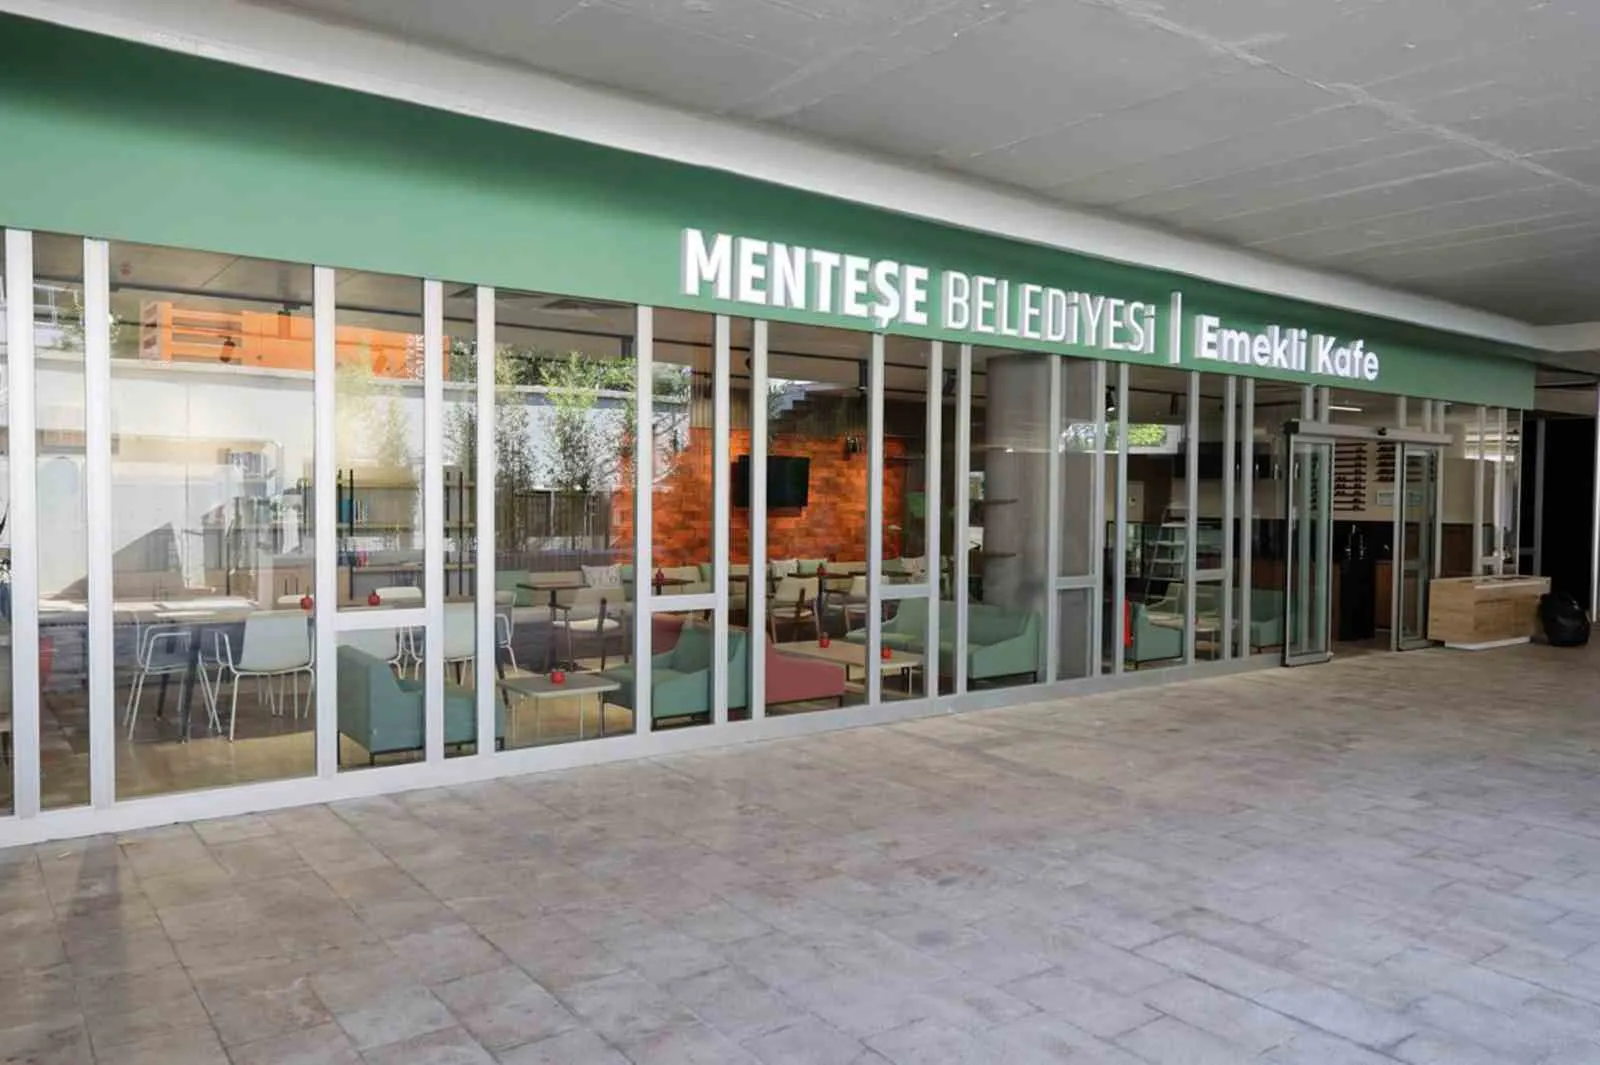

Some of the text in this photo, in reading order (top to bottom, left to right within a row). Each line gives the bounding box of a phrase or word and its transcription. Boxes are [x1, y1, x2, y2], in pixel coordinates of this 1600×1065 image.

[680, 228, 929, 328] MENTEŞE
[1194, 314, 1308, 371] Emekli
[1311, 333, 1379, 380] Kafe
